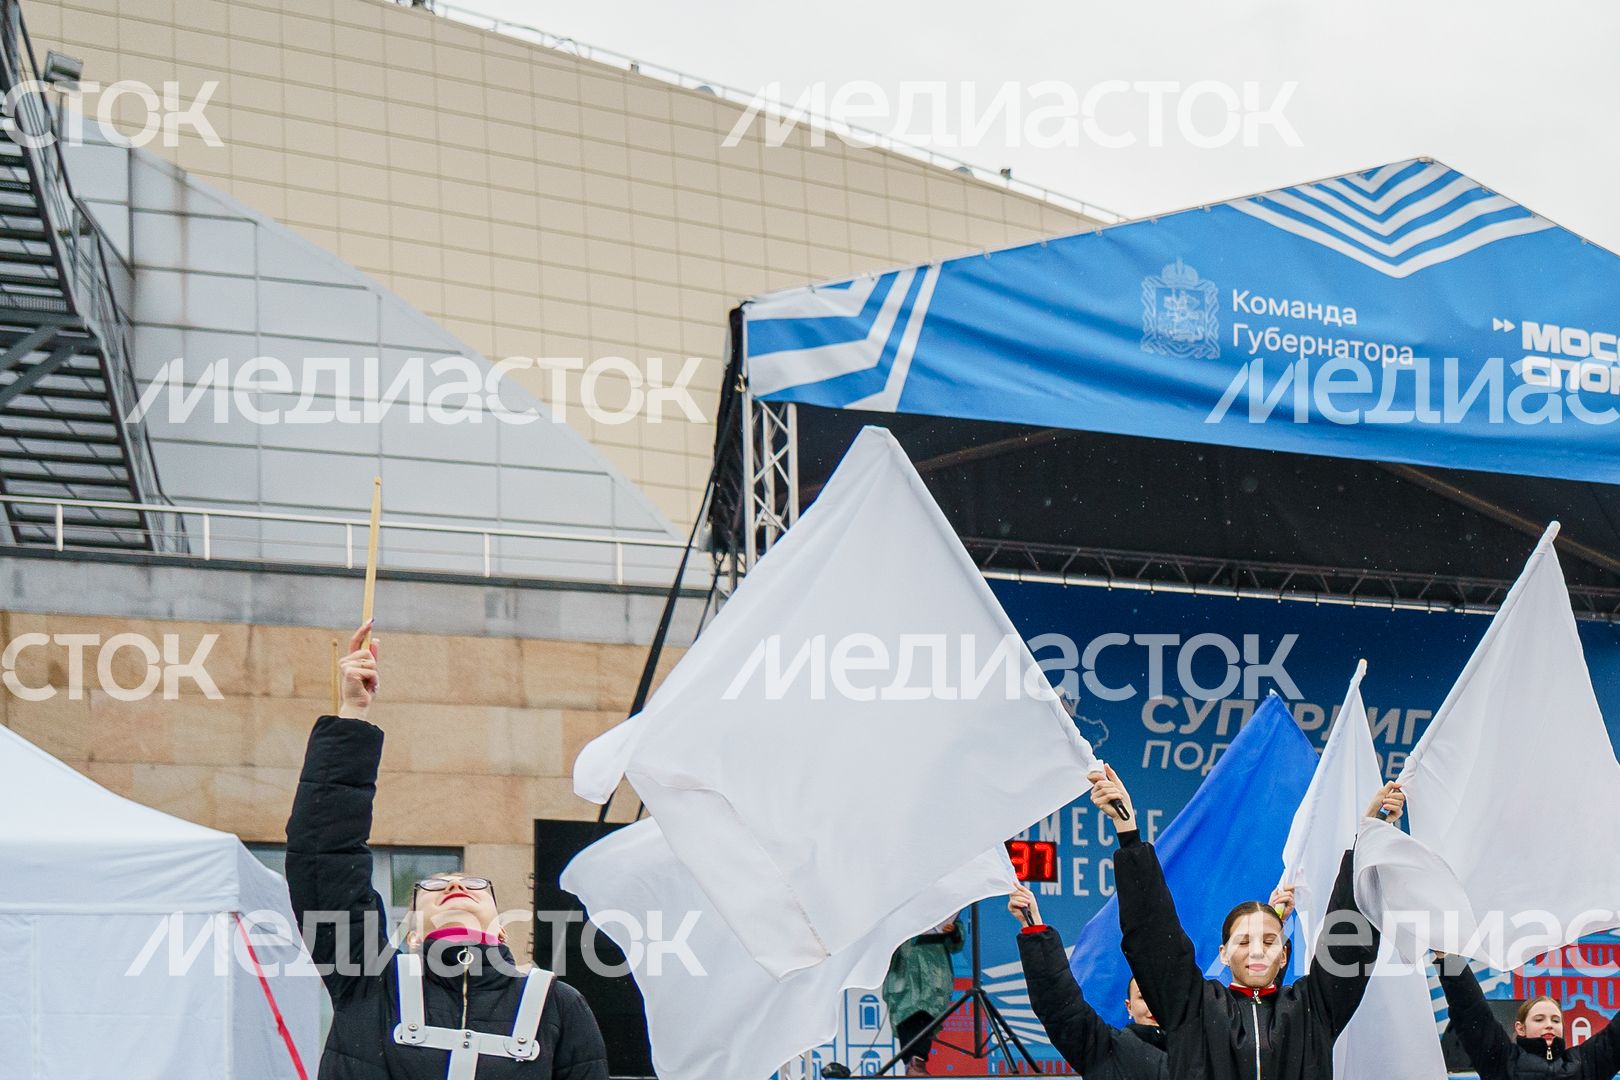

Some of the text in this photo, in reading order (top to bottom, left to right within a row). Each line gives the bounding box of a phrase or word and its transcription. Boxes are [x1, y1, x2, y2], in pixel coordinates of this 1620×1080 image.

[1232, 289, 1357, 327] Команда
[1232, 323, 1413, 367] Губернатора
[1011, 841, 1054, 880] 37
